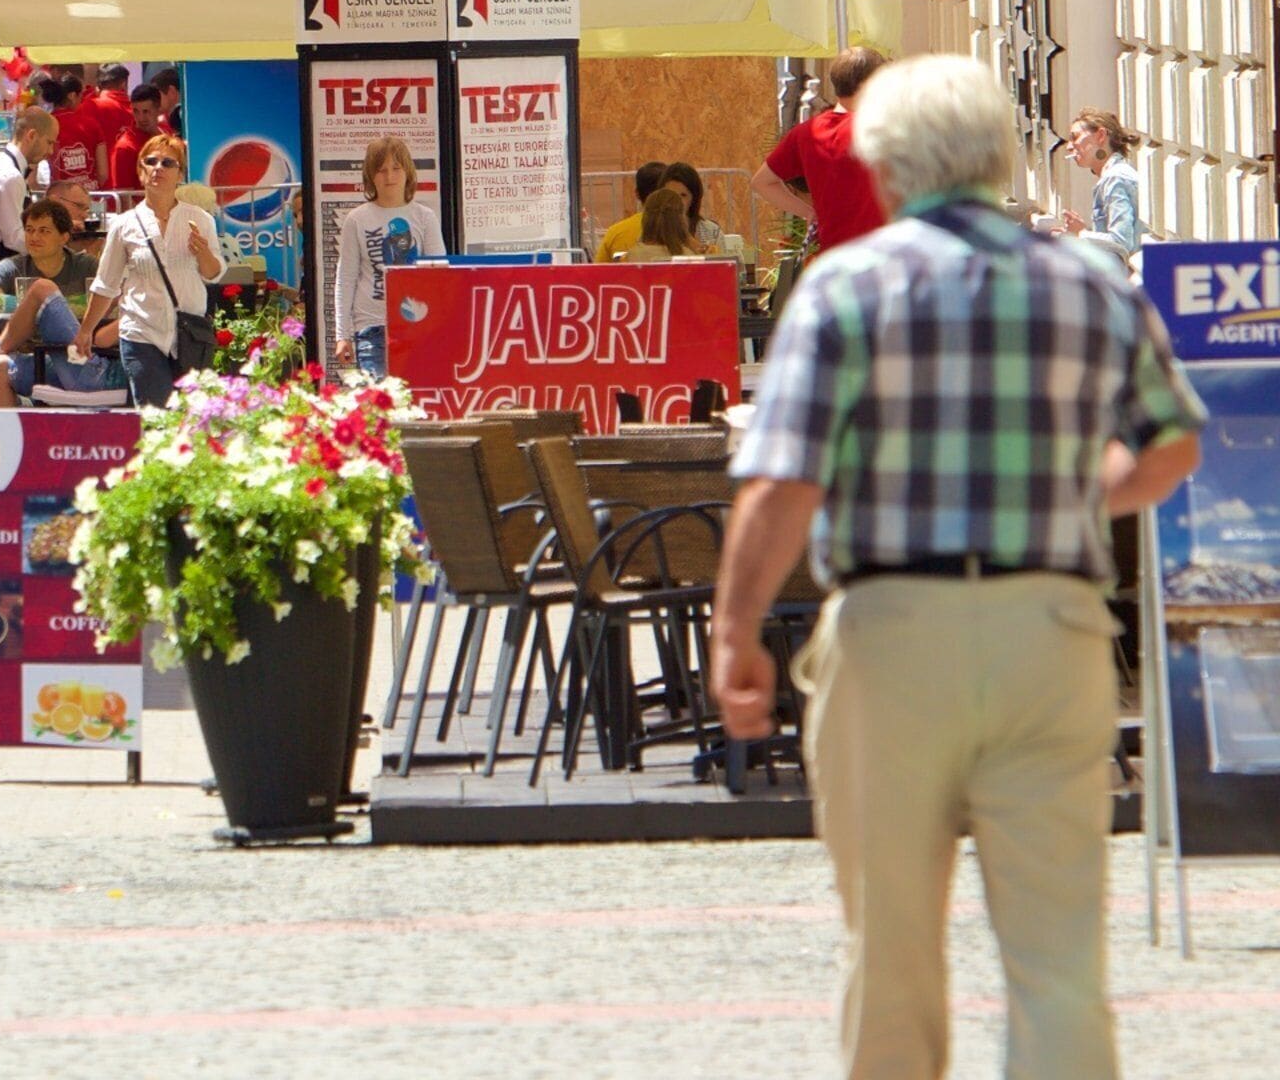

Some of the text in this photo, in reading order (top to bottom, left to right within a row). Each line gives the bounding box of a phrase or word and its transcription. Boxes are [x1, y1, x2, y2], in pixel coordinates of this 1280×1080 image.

[318, 77, 434, 115] TESZT
[461, 83, 561, 124] TESZT
[464, 141, 511, 154] TEMESVÁRI
[464, 154, 510, 170] SZÍNHÁZI
[464, 175, 509, 186] FESTIVALUL
[465, 188, 478, 200] DE
[484, 186, 518, 200] TEATRU
[465, 215, 512, 228] FESTIVAL
[235, 225, 294, 253] epsi
[453, 284, 673, 383] JABRI
[48, 445, 125, 461] GELATO
